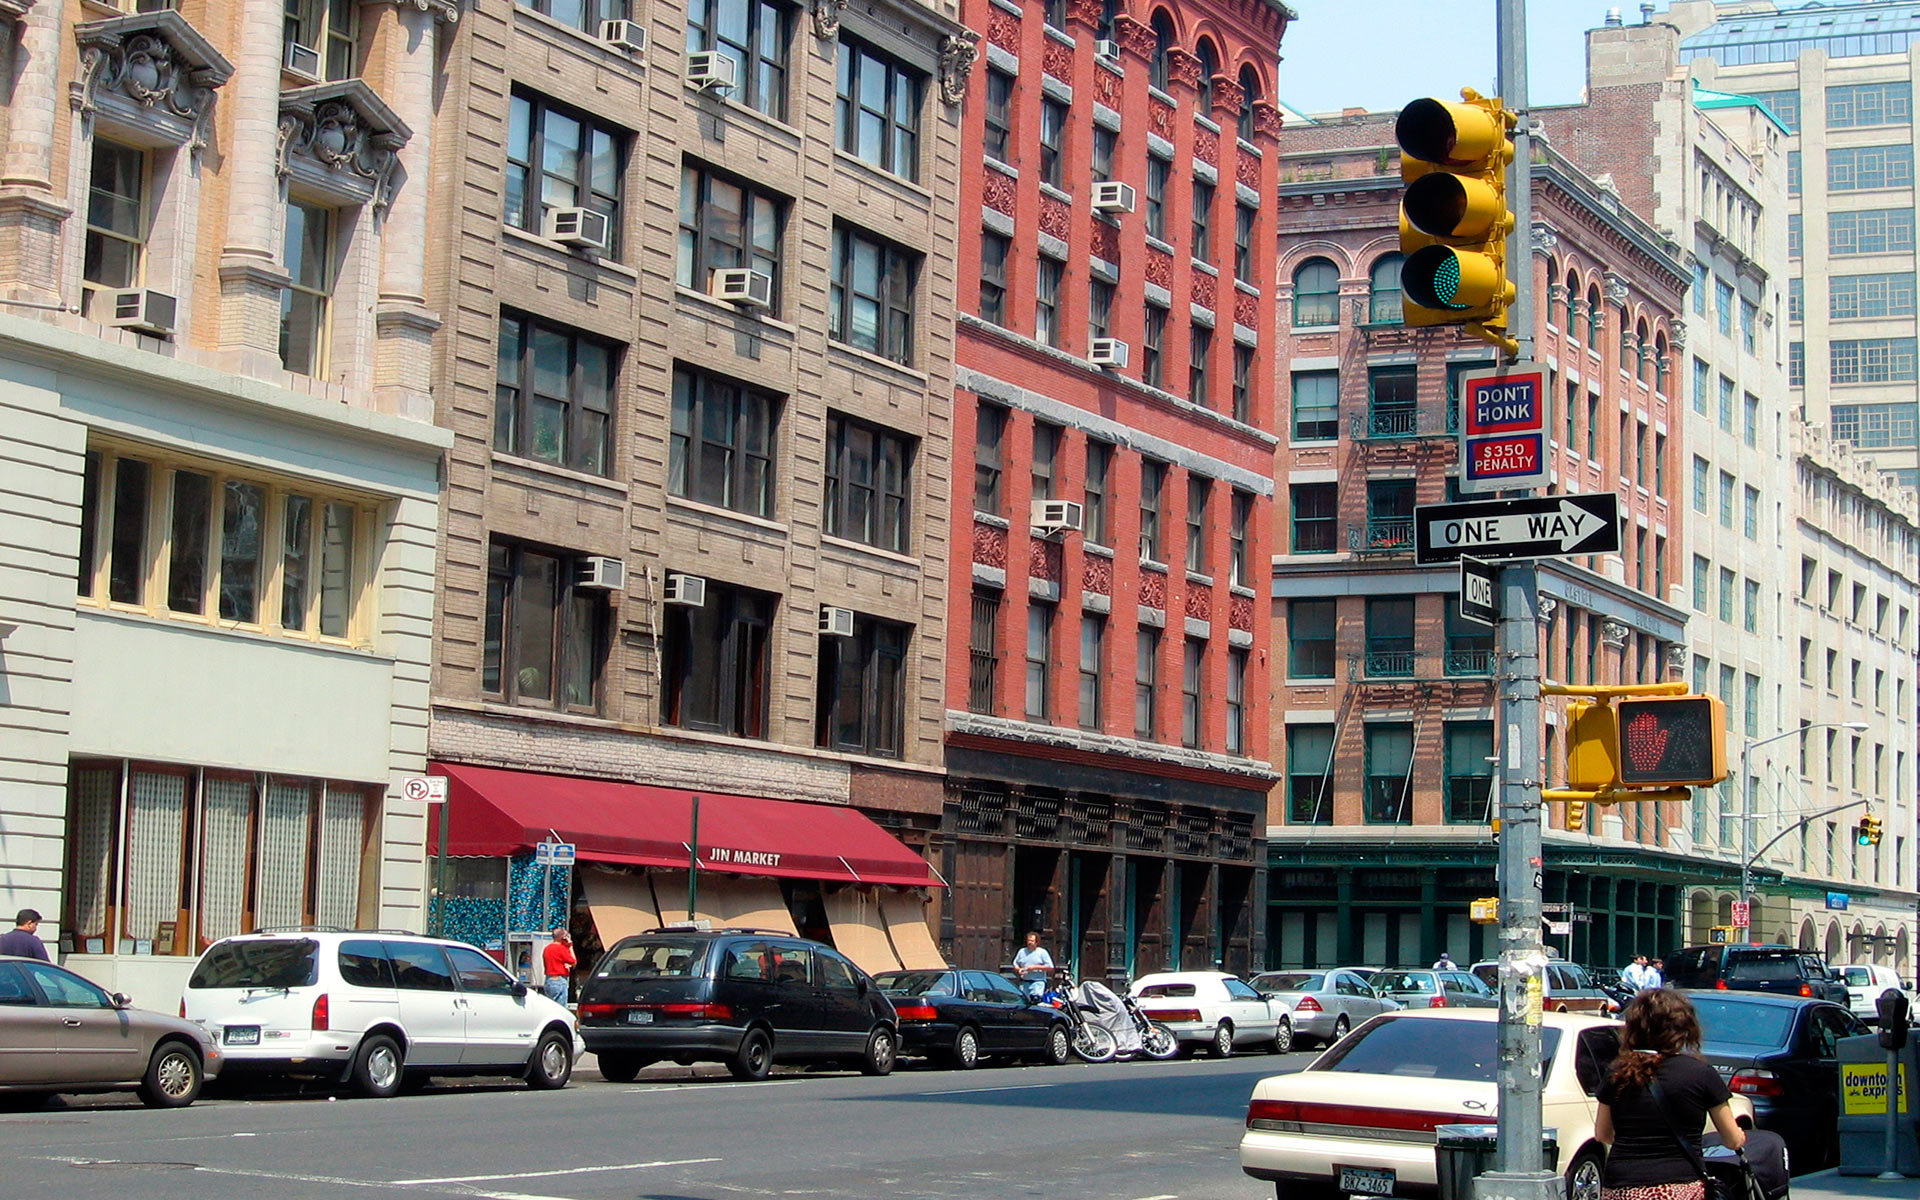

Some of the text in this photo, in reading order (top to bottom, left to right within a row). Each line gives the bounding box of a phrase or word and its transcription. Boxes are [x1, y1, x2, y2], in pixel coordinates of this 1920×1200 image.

[1477, 385, 1530, 405] DON'T
[1477, 404, 1530, 422] HONK
[1483, 443, 1525, 458] $350
[1474, 455, 1534, 473] PENALTY
[1445, 514, 1586, 545] ONE WAY
[1471, 578, 1491, 605] ONE
[709, 848, 780, 867] JIN MARKET
[1845, 1071, 1902, 1087] downton
[1862, 1085, 1903, 1099] exprs
